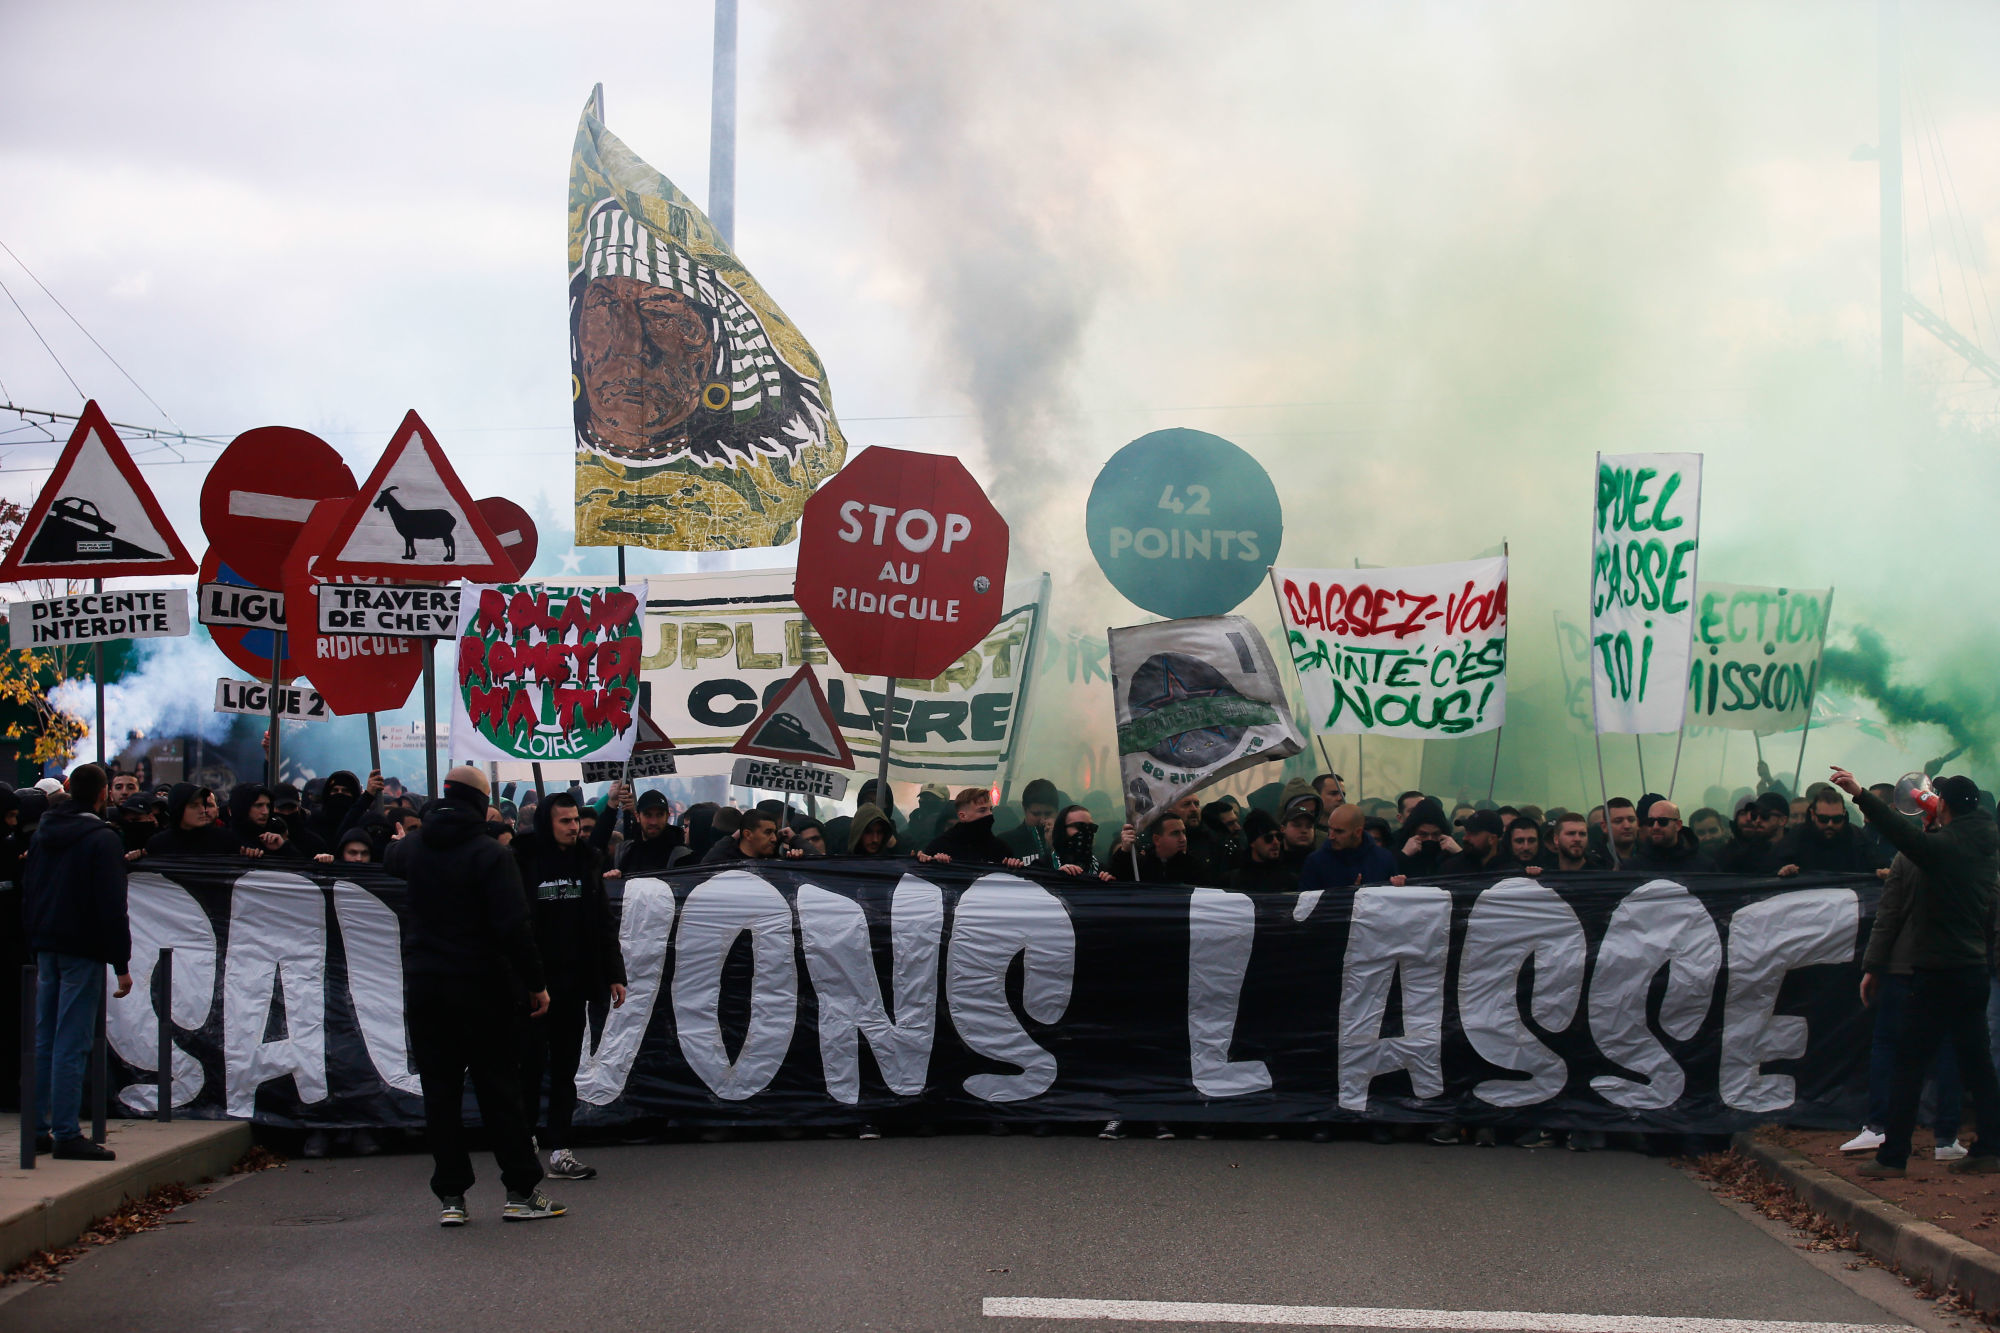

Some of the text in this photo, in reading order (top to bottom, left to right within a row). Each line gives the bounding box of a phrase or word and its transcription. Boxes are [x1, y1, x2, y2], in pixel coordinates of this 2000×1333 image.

[1157, 484, 1211, 515] 42
[1597, 463, 1683, 535] PUEL
[838, 500, 972, 553] STOP
[1110, 526, 1260, 562] POINTS
[878, 560, 920, 585] AU
[1594, 537, 1695, 617] CASSE
[32, 592, 166, 620] DESCENTE
[211, 590, 287, 624] LIGU
[334, 588, 461, 611] TRAVERS
[832, 586, 960, 622] RIDICULE
[32, 614, 169, 642] INTERDITE
[328, 610, 461, 632] DE CHEV
[316, 635, 410, 660] RIDICULE
[641, 620, 829, 670] UPLE
[223, 683, 324, 716] LIGUE 2
[1324, 678, 1495, 734] NOUS!
[513, 729, 588, 757] LOIRE
[745, 773, 833, 797] INTERDITE
[749, 762, 835, 786] DESCENTE
[1187, 876, 1860, 1112] L'ASSE
